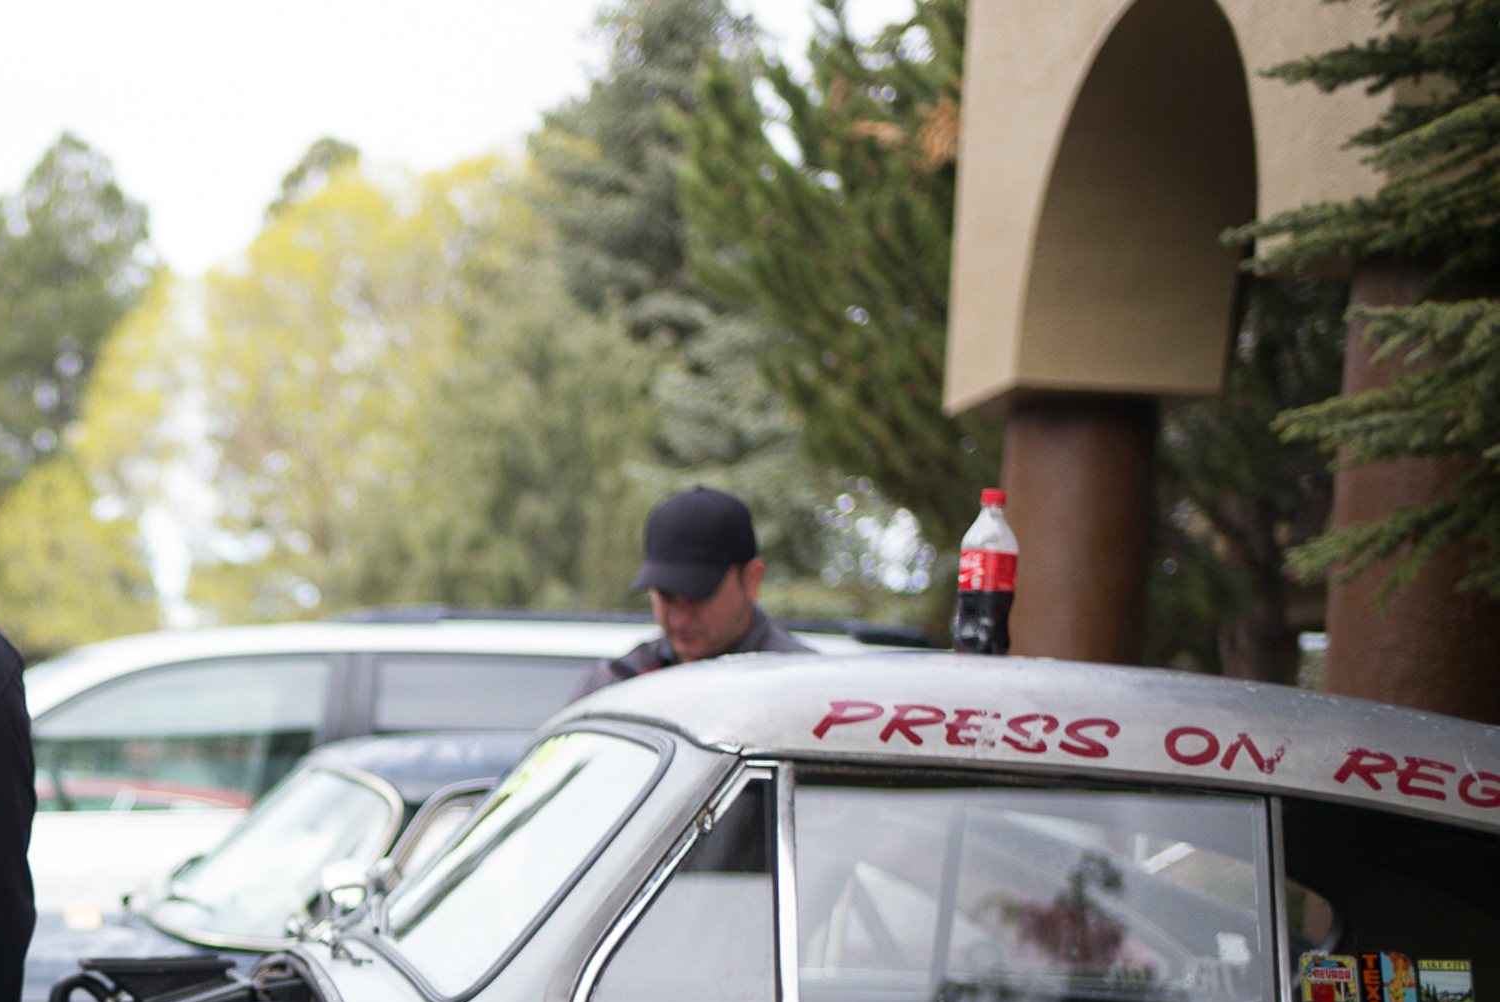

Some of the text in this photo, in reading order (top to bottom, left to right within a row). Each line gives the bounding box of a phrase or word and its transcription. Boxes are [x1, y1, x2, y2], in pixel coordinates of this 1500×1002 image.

[812, 699, 1500, 808] PRESS ON REG
